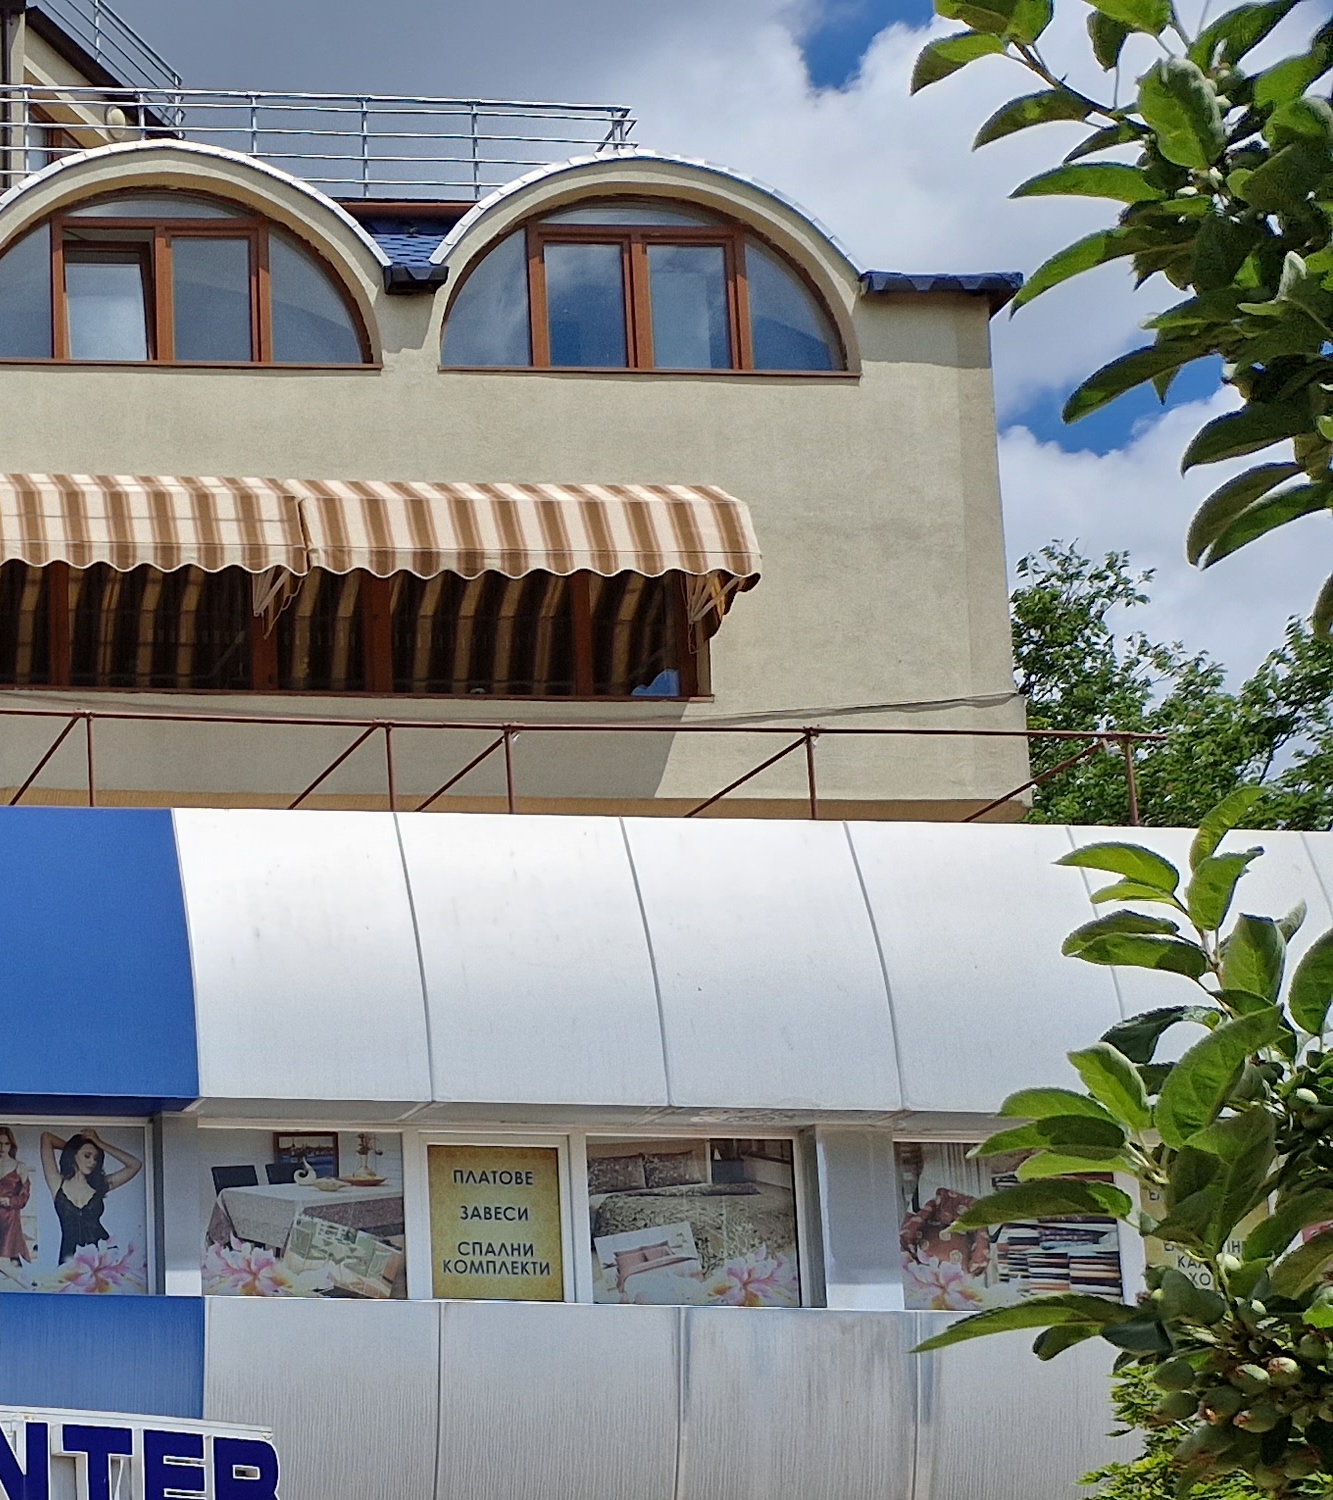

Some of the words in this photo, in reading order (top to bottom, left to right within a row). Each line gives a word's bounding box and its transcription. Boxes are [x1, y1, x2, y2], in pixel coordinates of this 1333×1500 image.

[453, 1169, 534, 1187] ПЛАТОВЕ
[460, 1205, 530, 1222] ЗАВЕСИ
[457, 1241, 535, 1258] СПАЛНИ
[443, 1258, 552, 1277] КОМПЛЕКТИ
